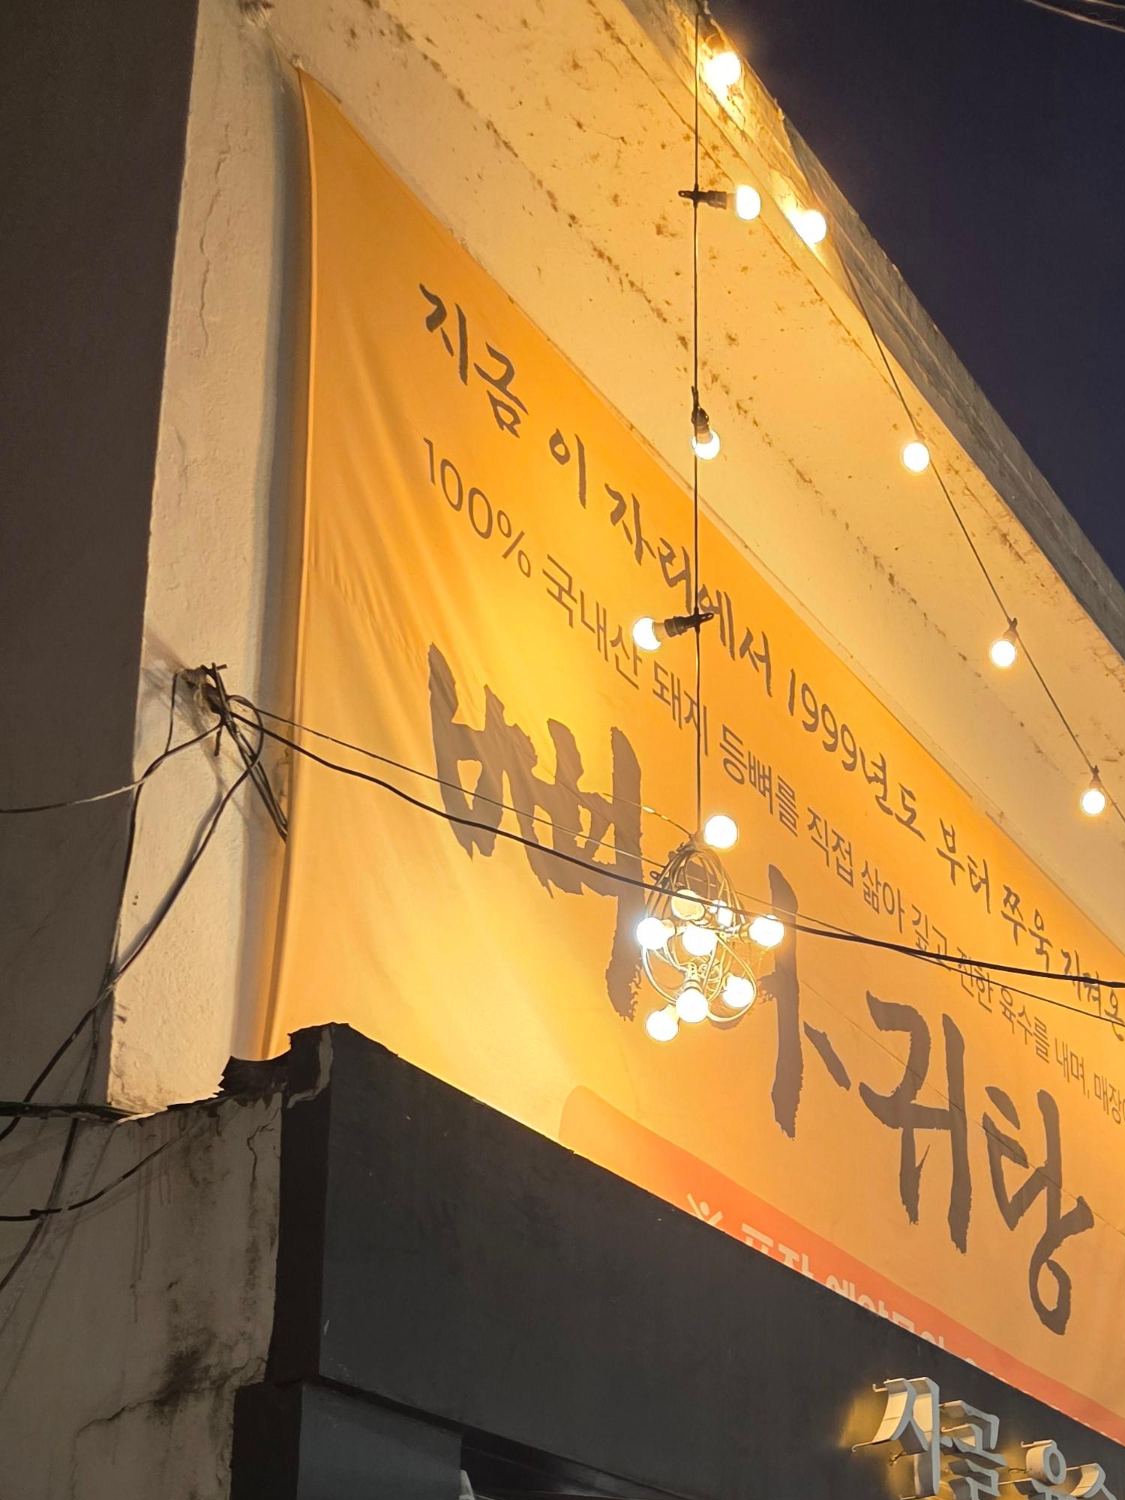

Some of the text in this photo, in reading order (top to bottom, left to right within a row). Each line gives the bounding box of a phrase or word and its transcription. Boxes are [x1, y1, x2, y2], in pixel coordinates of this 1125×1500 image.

[419, 283, 529, 439] 지금
[548, 428, 587, 509] 이
[604, 483, 773, 698] 자리에서
[1001, 883, 1055, 971] 쭈욱
[423, 437, 532, 578] 100%
[541, 553, 643, 691] 국내산
[652, 659, 709, 756] 돼지
[719, 723, 799, 838] 등뼈를
[806, 806, 855, 888] 직접
[861, 860, 905, 934] 삶아
[911, 903, 952, 972] 깊고
[956, 946, 994, 1014] 진한
[999, 986, 1050, 1064] 육수를
[1054, 1037, 1091, 1100] 내며,
